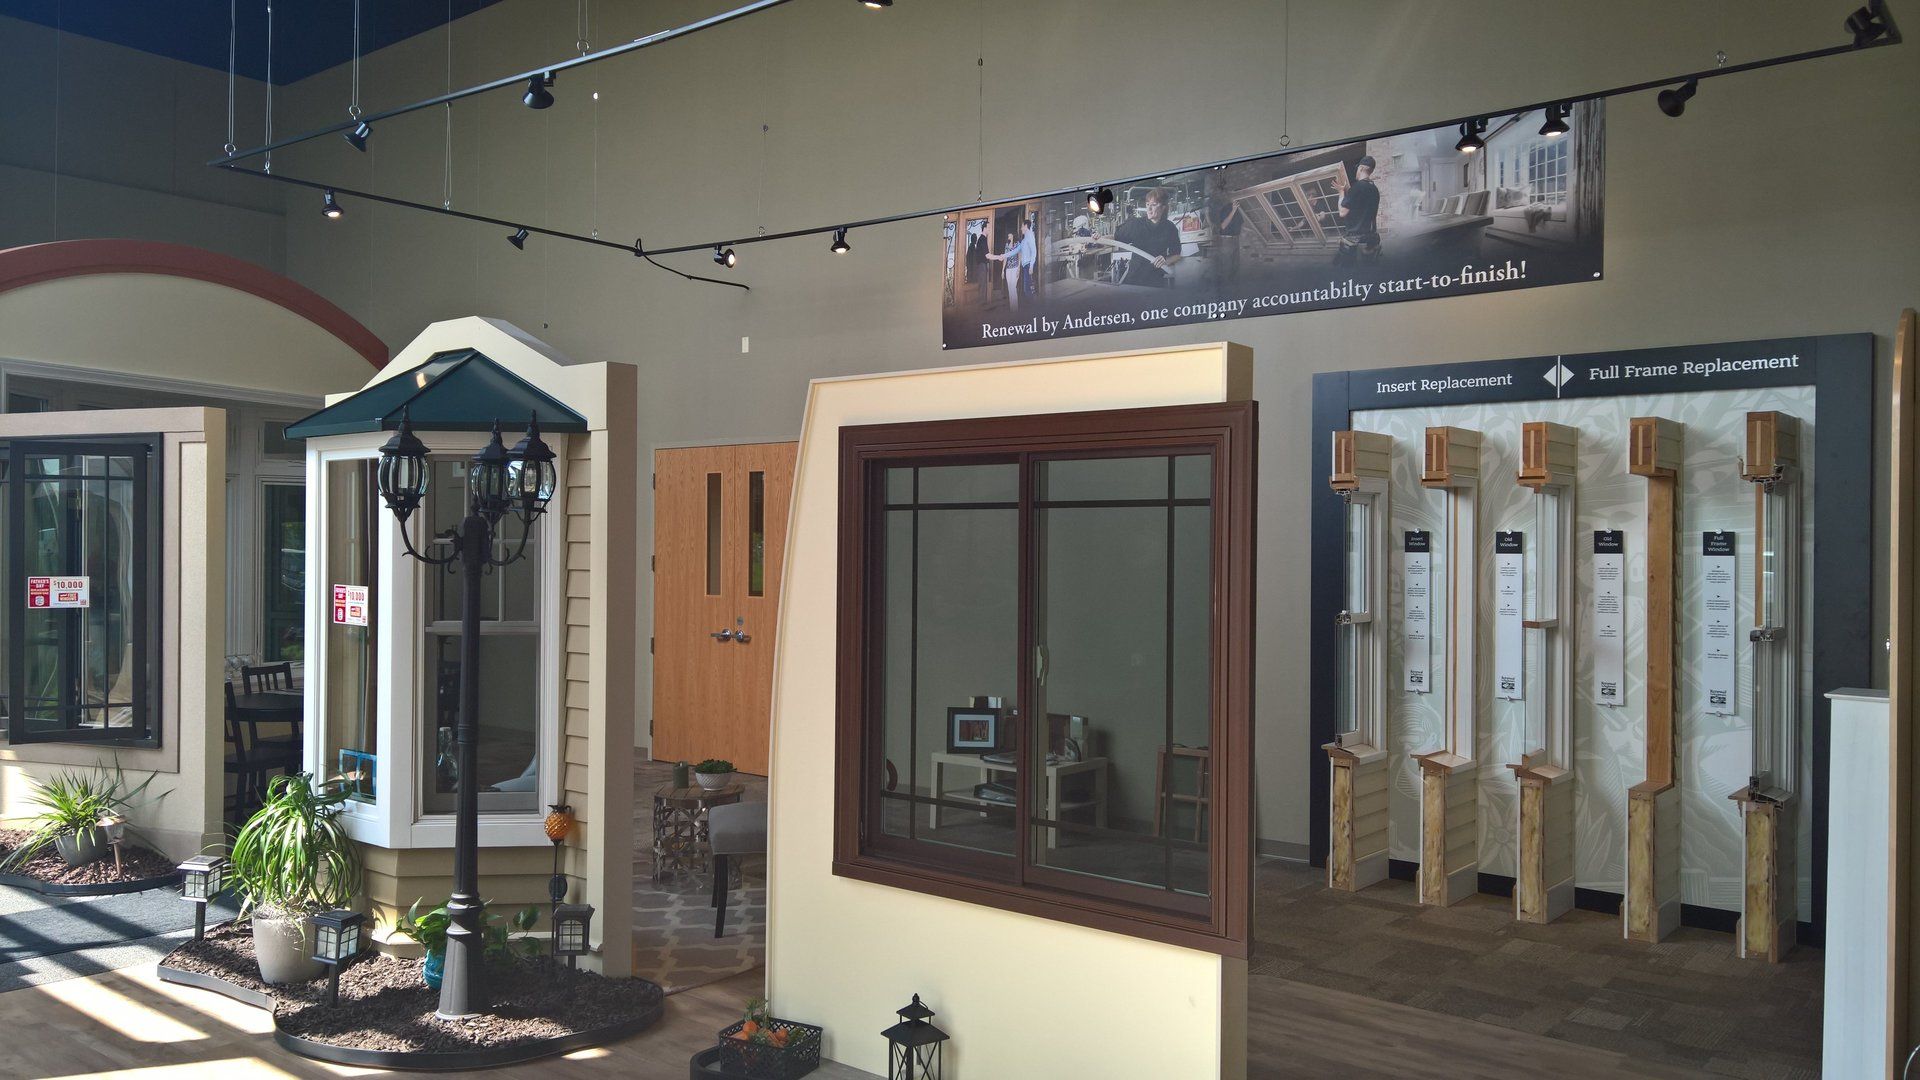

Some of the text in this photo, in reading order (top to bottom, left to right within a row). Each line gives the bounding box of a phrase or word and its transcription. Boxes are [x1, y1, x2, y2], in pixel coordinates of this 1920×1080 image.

[982, 260, 1527, 339] Renewal by Andersen, one company accountabilty start-to-finish!
[1589, 354, 1799, 381] Full Frame Replacement
[1377, 374, 1513, 393] Insert Replacement
